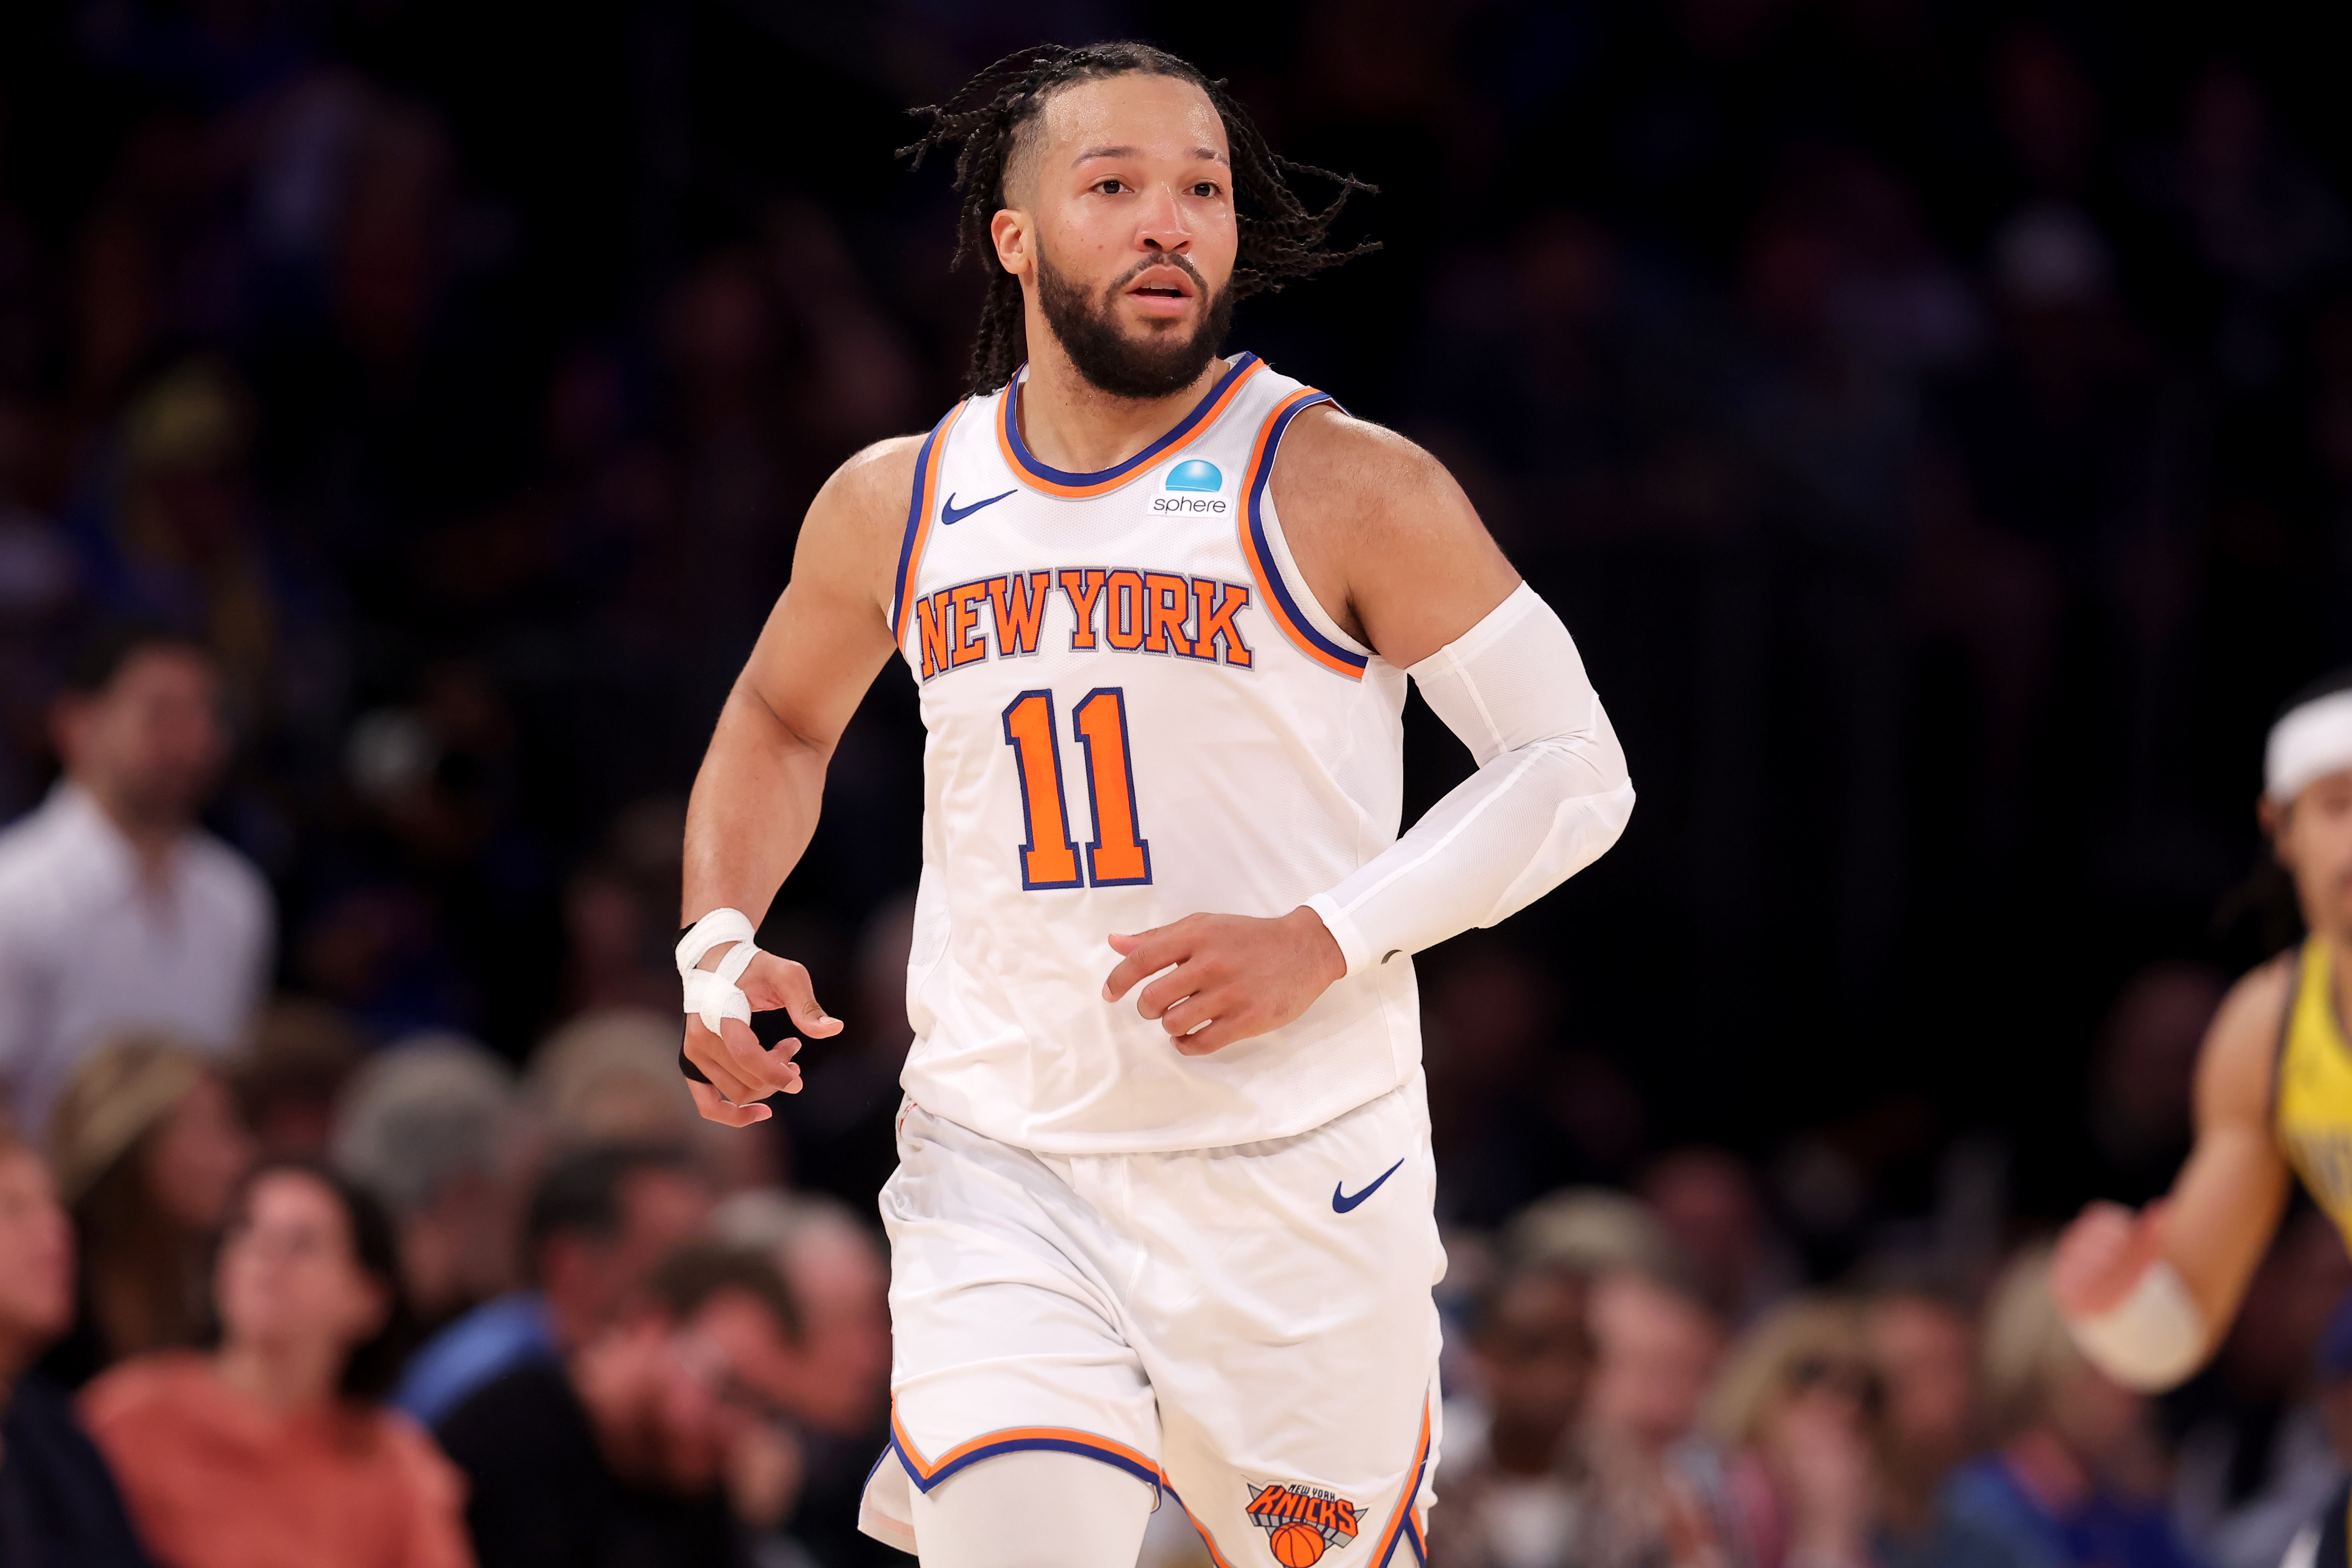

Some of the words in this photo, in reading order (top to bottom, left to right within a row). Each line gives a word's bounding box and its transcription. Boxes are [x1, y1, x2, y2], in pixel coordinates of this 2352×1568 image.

[1153, 496, 1226, 514] sphere
[916, 567, 1053, 686] NEW
[1055, 566, 1255, 671] YORK
[1002, 687, 1153, 891] 11
[1246, 1485, 1359, 1538] KNICKS
[1288, 1484, 1310, 1494] NEW
[1313, 1487, 1335, 1502] YORK
